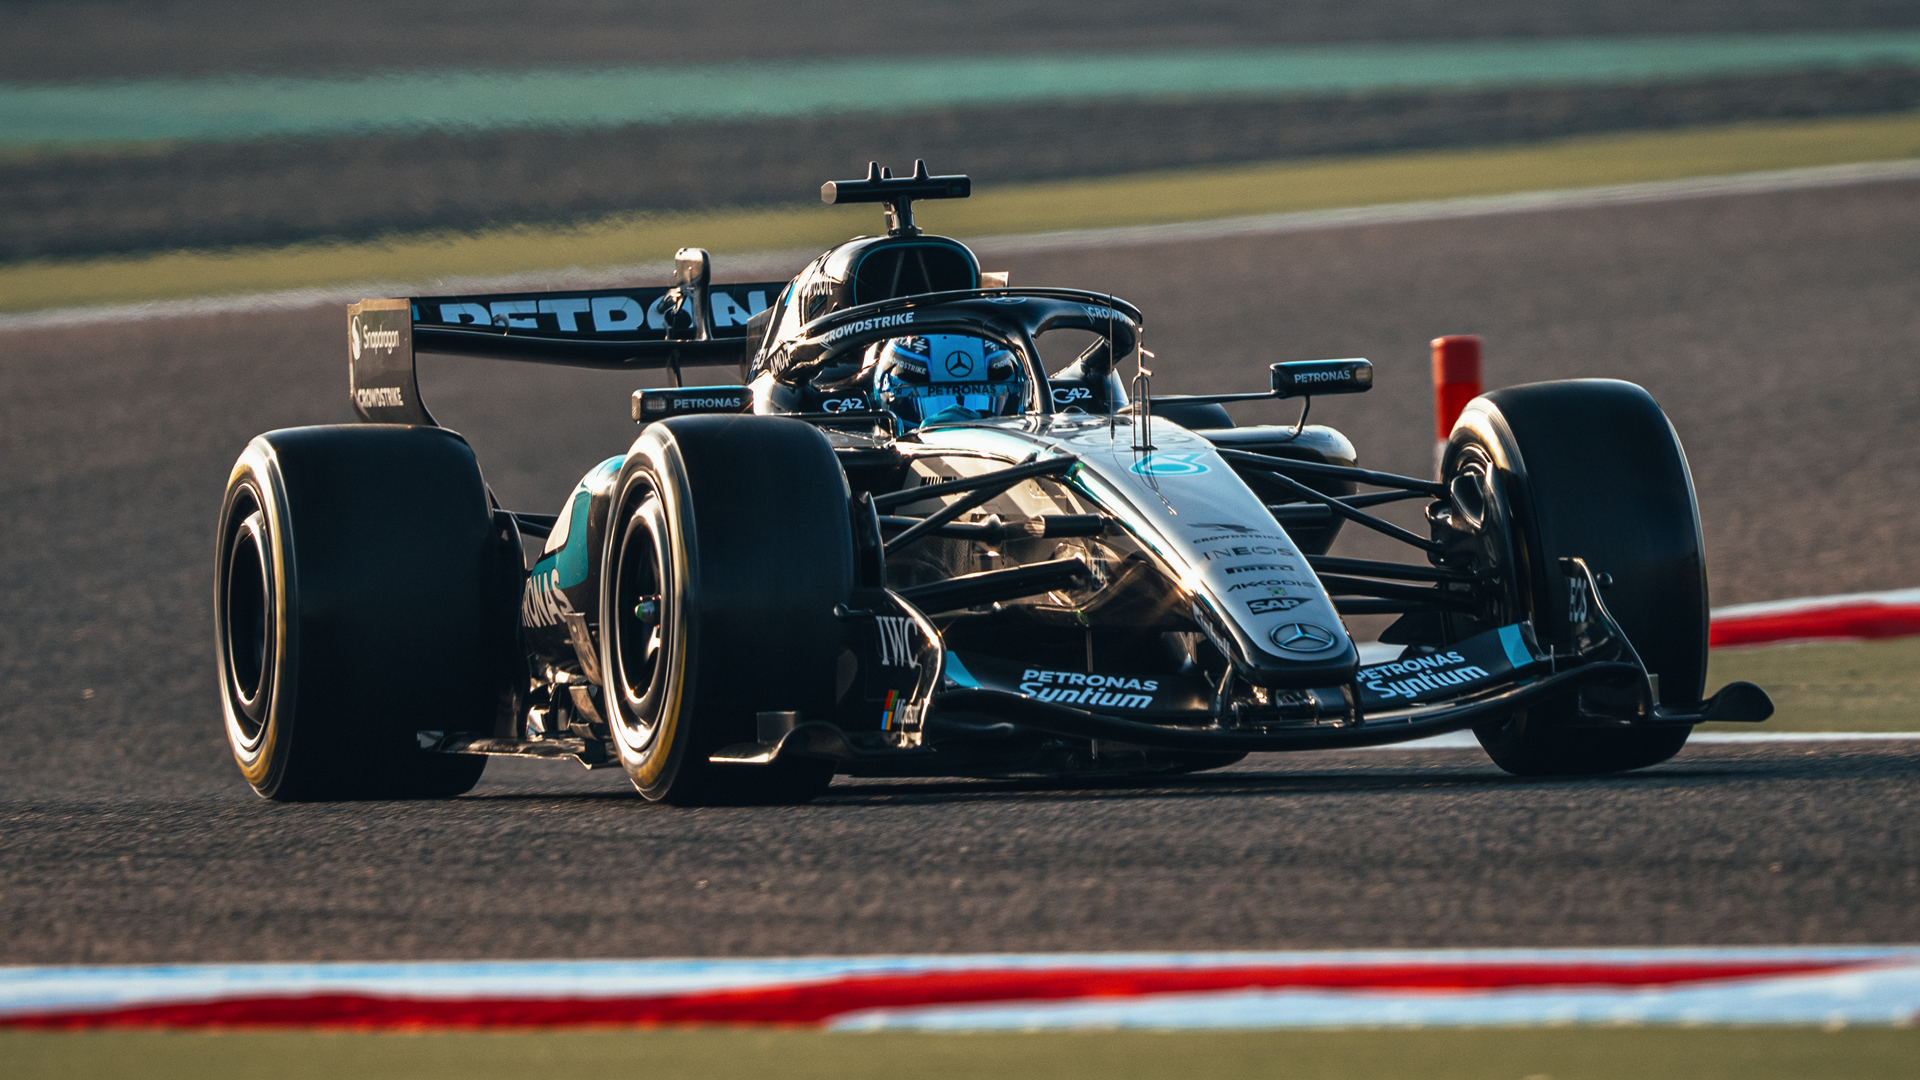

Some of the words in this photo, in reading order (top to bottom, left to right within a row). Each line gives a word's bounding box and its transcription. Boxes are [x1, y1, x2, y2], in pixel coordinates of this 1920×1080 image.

[822, 312, 915, 344] CROWDSTRIKE
[363, 324, 400, 355] Snapdragon
[1294, 369, 1351, 383] PETRONAS
[928, 385, 996, 397] PETRONAS
[673, 397, 741, 409] PETRONAS
[1193, 534, 1283, 544] CROWDSTRIKE
[1203, 546, 1295, 561] INEOS
[1225, 564, 1295, 575] PIRELLI
[1227, 579, 1316, 592] AKKODIS
[1250, 600, 1300, 612] SAP
[876, 616, 918, 669] IWC
[1357, 651, 1466, 683] PETRONAS
[1022, 669, 1159, 692] PETRONAS
[1368, 665, 1489, 698] Syntium
[1020, 682, 1153, 709] Syntium
